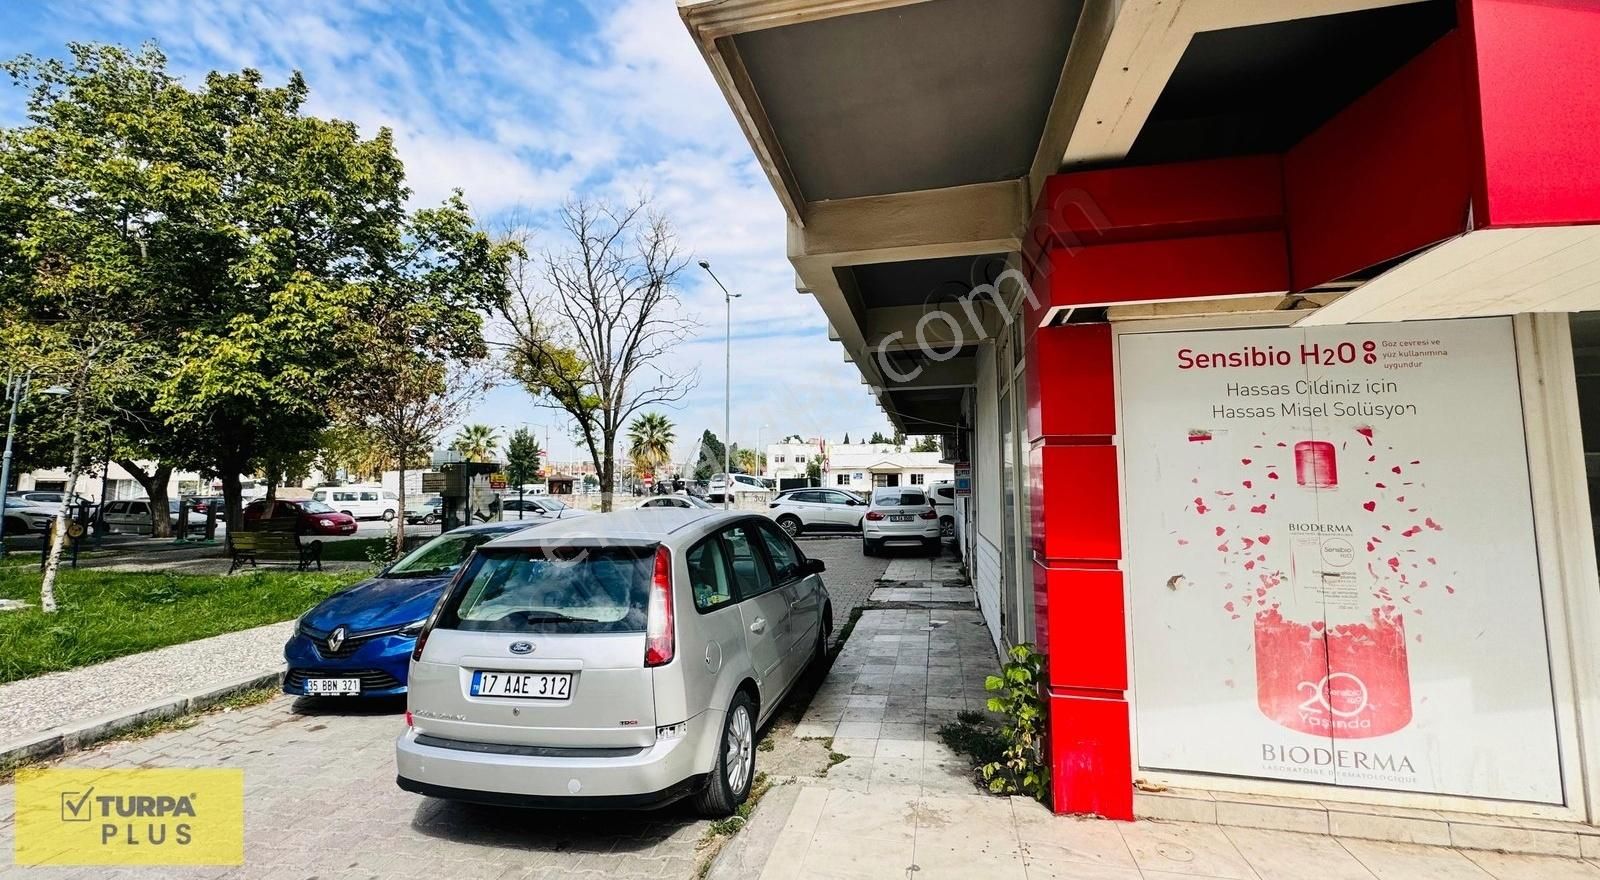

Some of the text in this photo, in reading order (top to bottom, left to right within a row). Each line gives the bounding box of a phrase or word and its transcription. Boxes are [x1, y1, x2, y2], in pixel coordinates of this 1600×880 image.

[1177, 346, 1291, 370] Sensibio
[1226, 377, 1398, 398] Hassas Cildiniz için
[1212, 401, 1417, 420] Hassas Misel Solüsyon
[1288, 523, 1353, 533] BIODERMA
[308, 680, 357, 691] 35 BBN 321
[482, 675, 498, 693] 17
[504, 676, 529, 694] AAE
[539, 677, 568, 696] 312
[1262, 744, 1416, 774] BIODERMA
